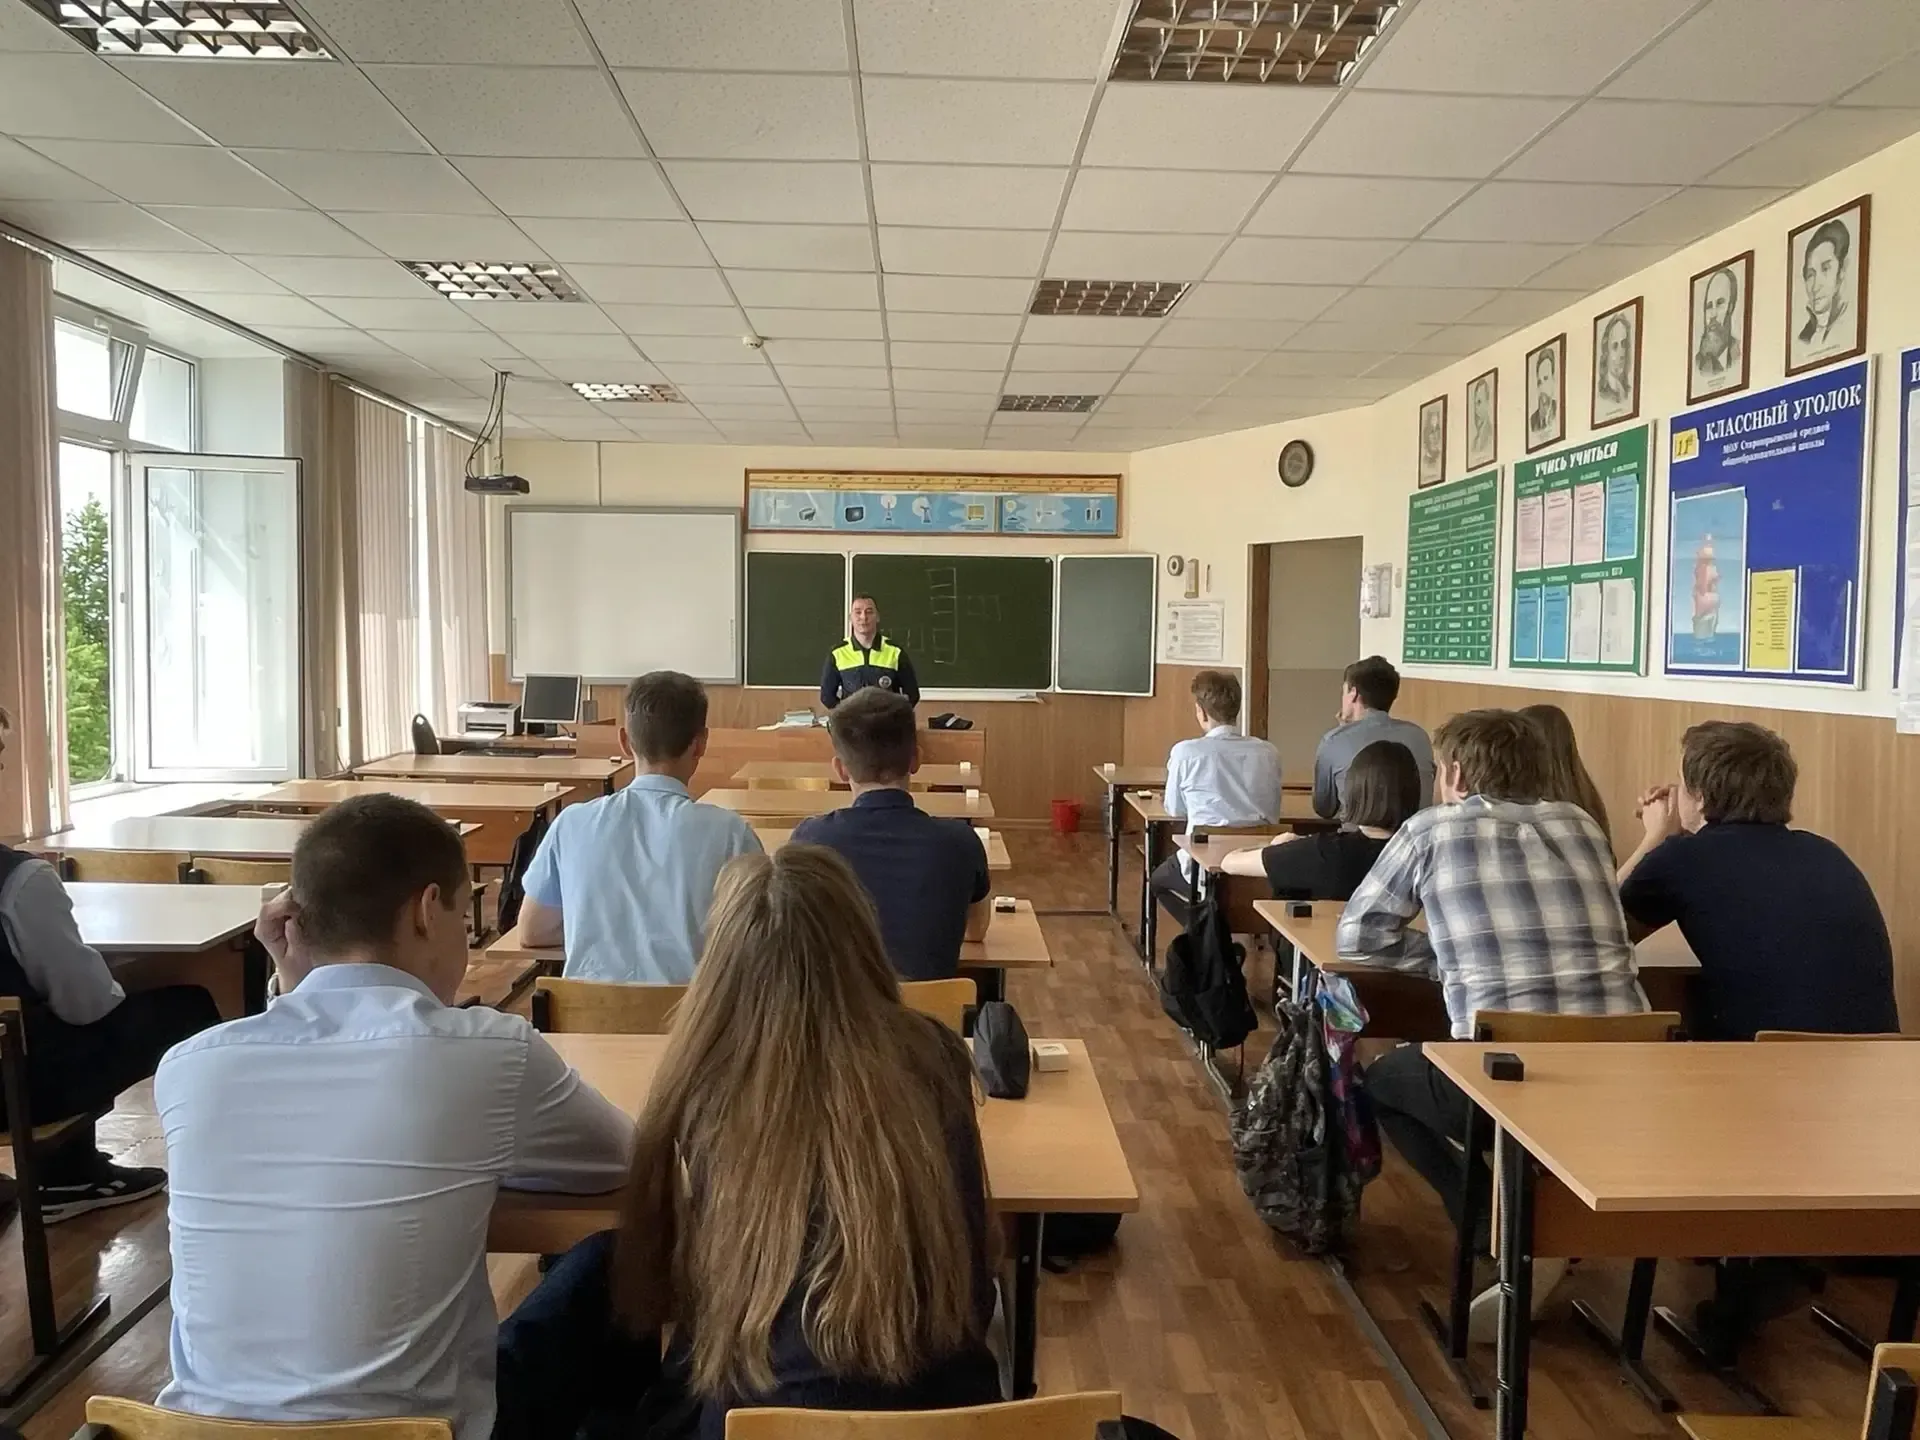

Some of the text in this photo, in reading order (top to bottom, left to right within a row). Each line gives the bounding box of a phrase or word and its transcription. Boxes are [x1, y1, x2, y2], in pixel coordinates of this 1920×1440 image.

[1705, 399, 1789, 442] КЛАССНЫЙ
[1793, 384, 1862, 421] УГОЛОК
[1535, 456, 1568, 477] УЧИСЬ
[1569, 441, 1619, 468] УЧИТЬСЯ
